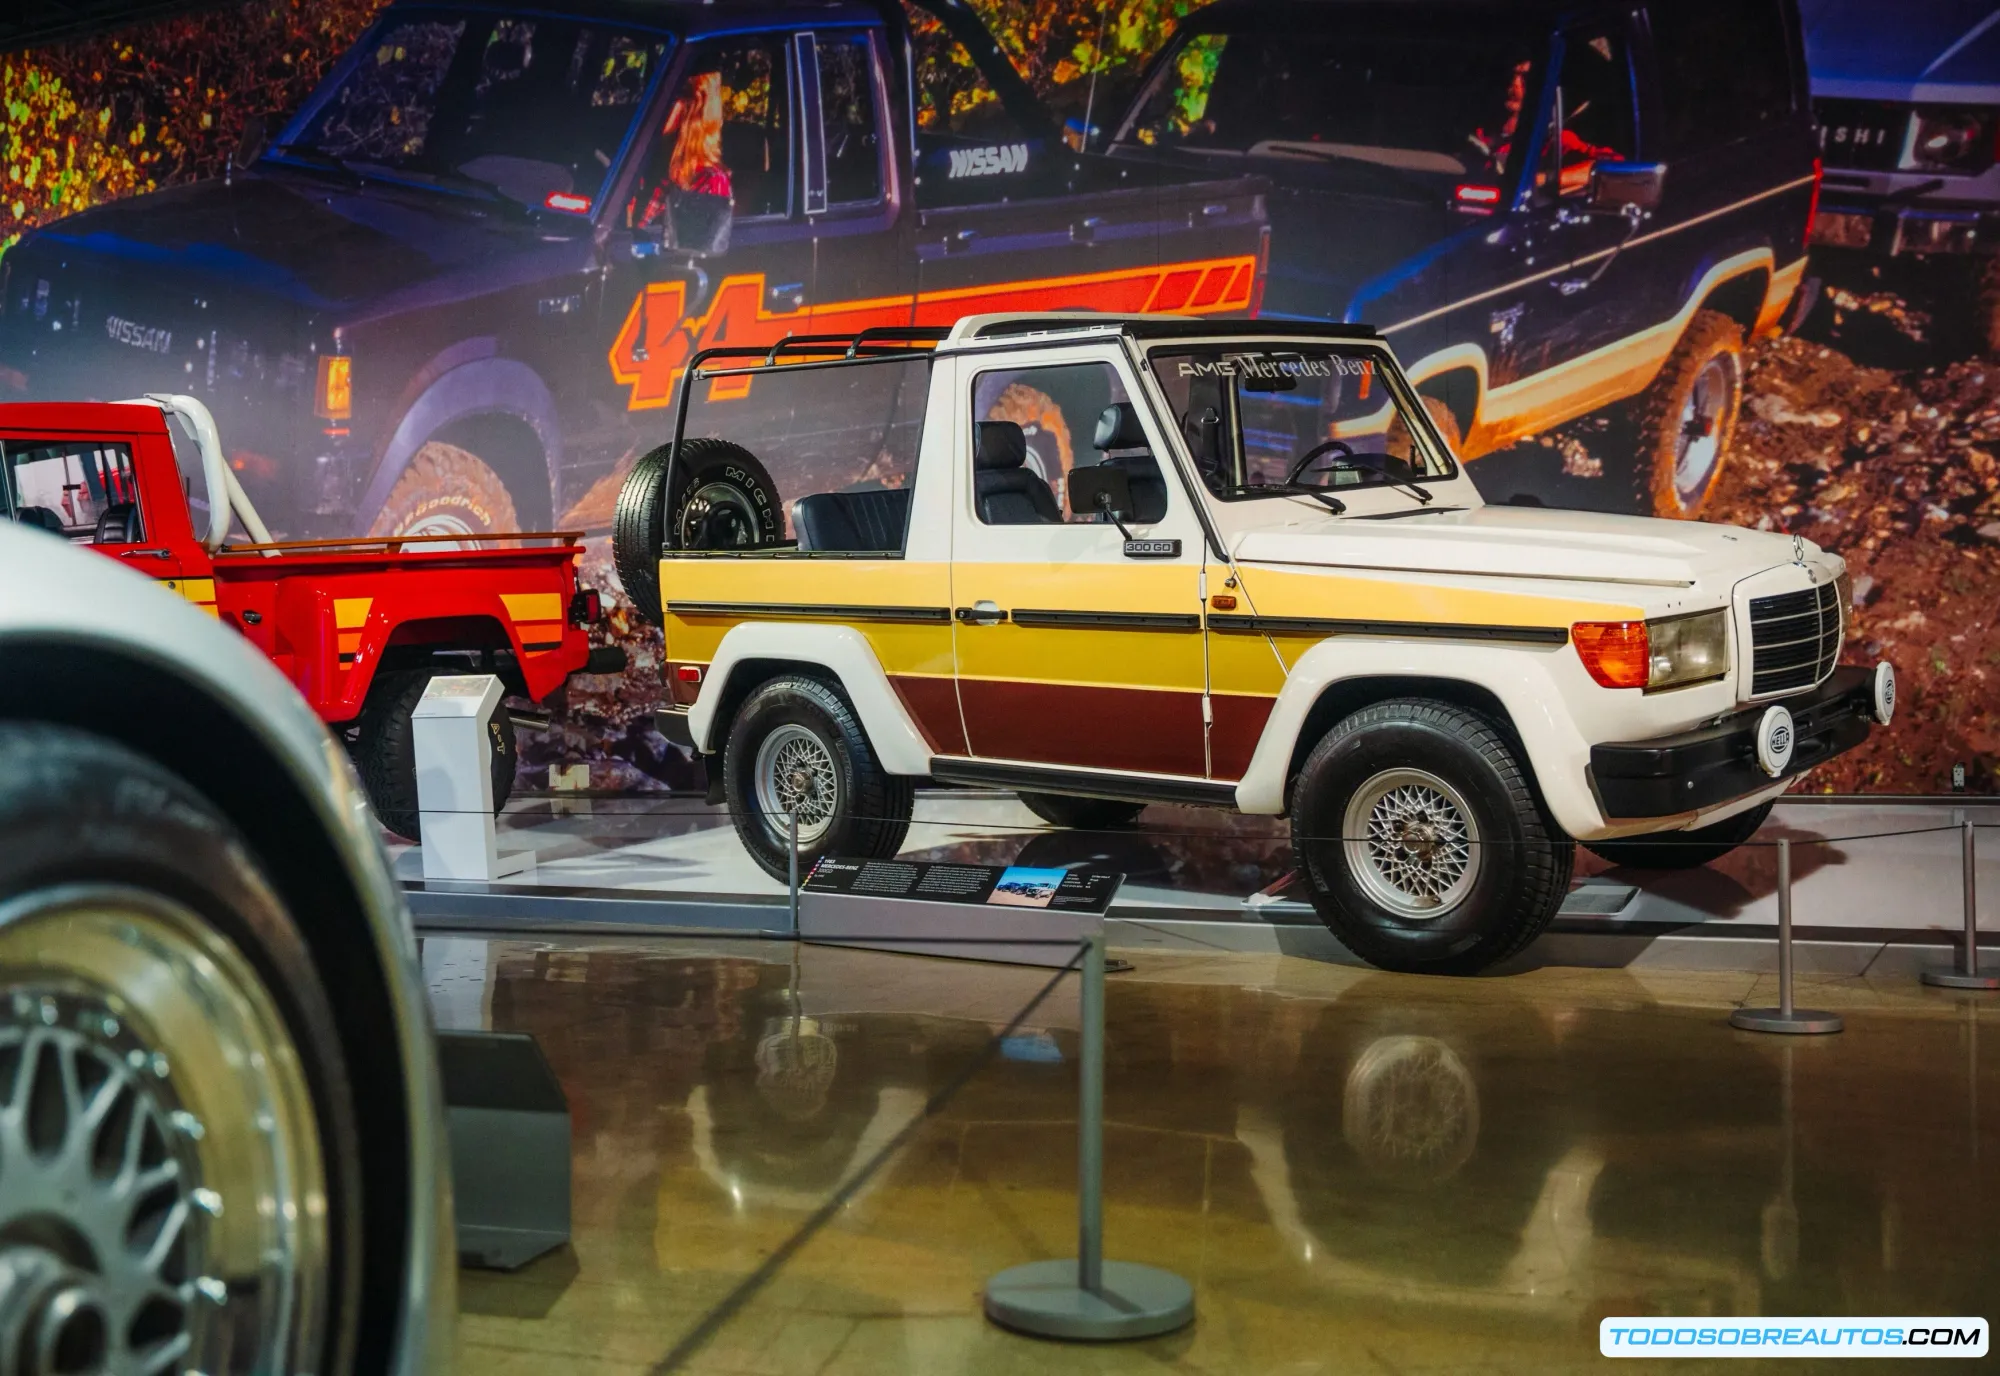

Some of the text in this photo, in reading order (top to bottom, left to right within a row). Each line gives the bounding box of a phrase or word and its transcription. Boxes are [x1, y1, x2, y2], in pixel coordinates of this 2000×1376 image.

[948, 144, 1028, 178] NISSAN
[106, 315, 172, 353] NISSAN
[1178, 361, 1237, 377] AMG
[1234, 354, 1331, 379] Mercedes
[1126, 543, 1171, 552] 300 GD
[1771, 731, 1790, 746] HELLA
